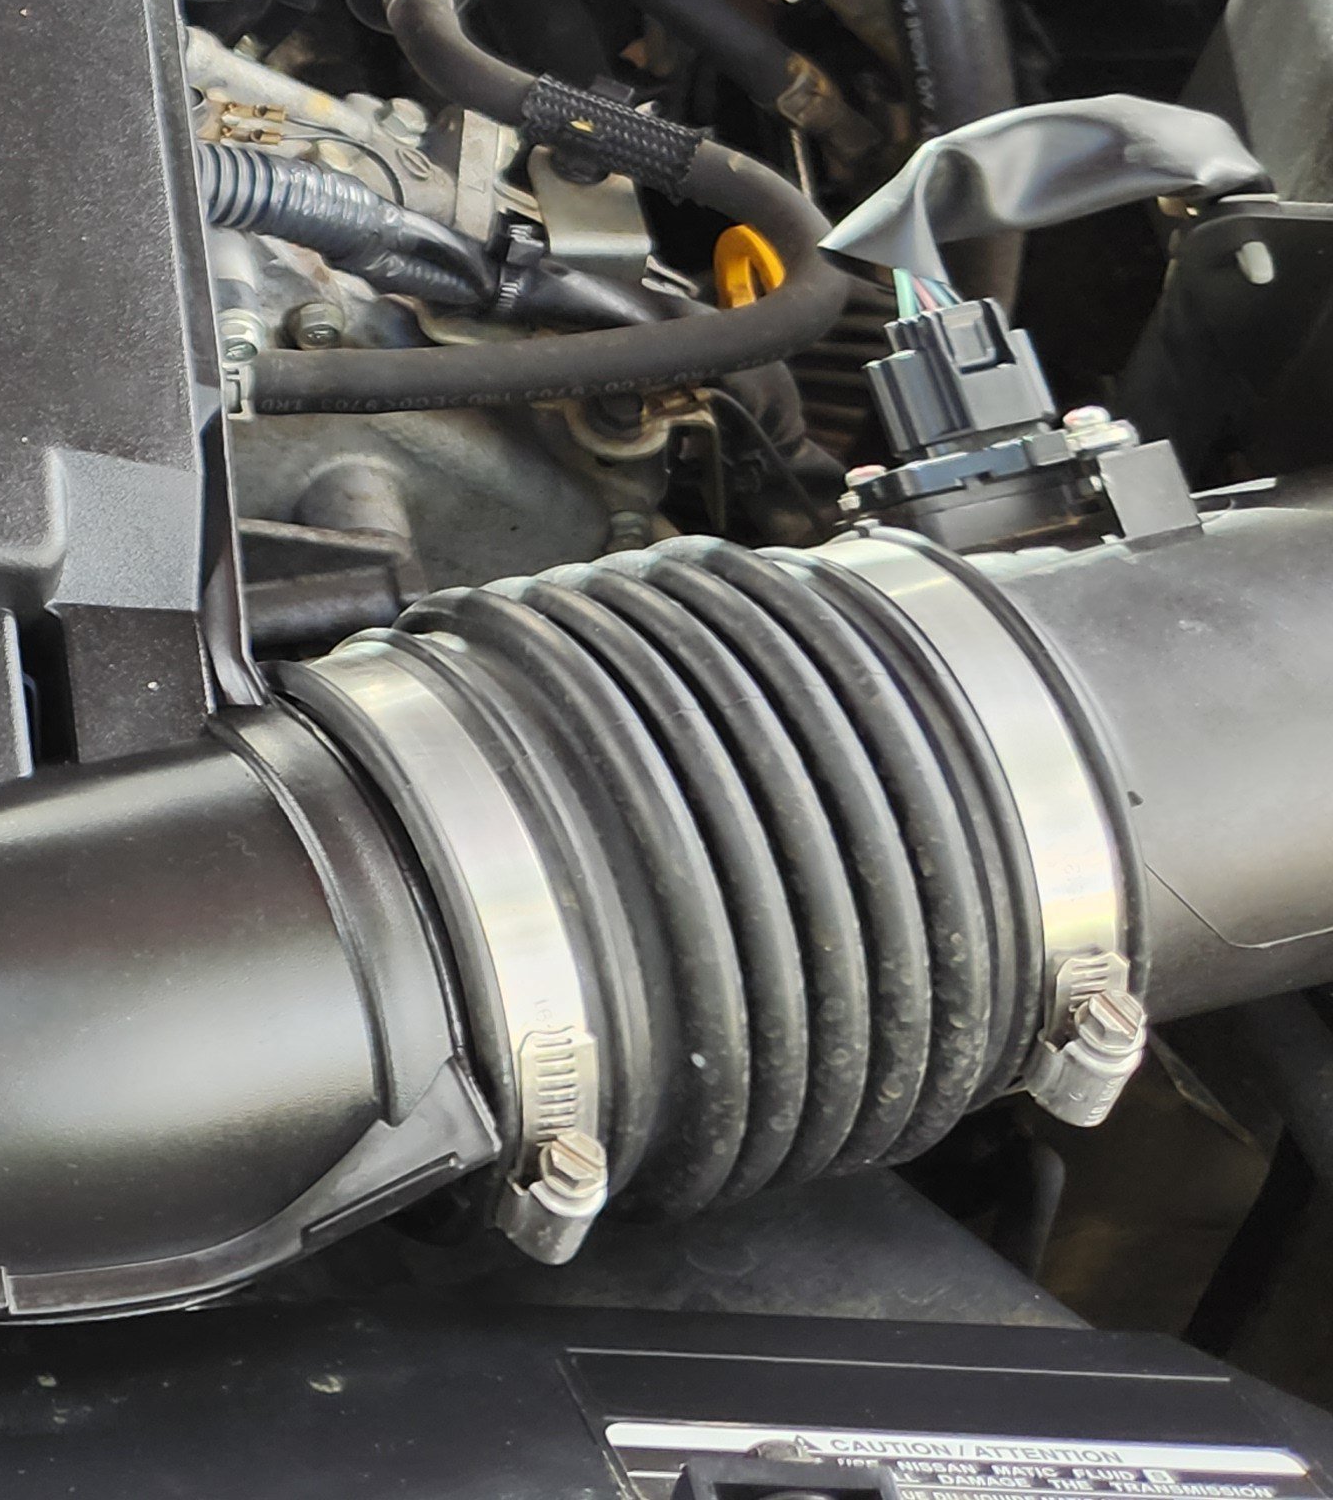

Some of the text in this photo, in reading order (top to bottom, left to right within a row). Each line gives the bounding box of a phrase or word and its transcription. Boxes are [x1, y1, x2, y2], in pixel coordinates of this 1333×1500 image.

[830, 1438, 953, 1457] CAUTION
[974, 1445, 1124, 1464] ATTENTION
[896, 1460, 978, 1474] NISSAN
[990, 1464, 1058, 1479] MATIC
[1072, 1467, 1136, 1481] FLUID
[936, 1473, 1032, 1488] DAMAGE
[1047, 1478, 1094, 1491] THE
[1108, 1481, 1275, 1499] TRANSMISSION
